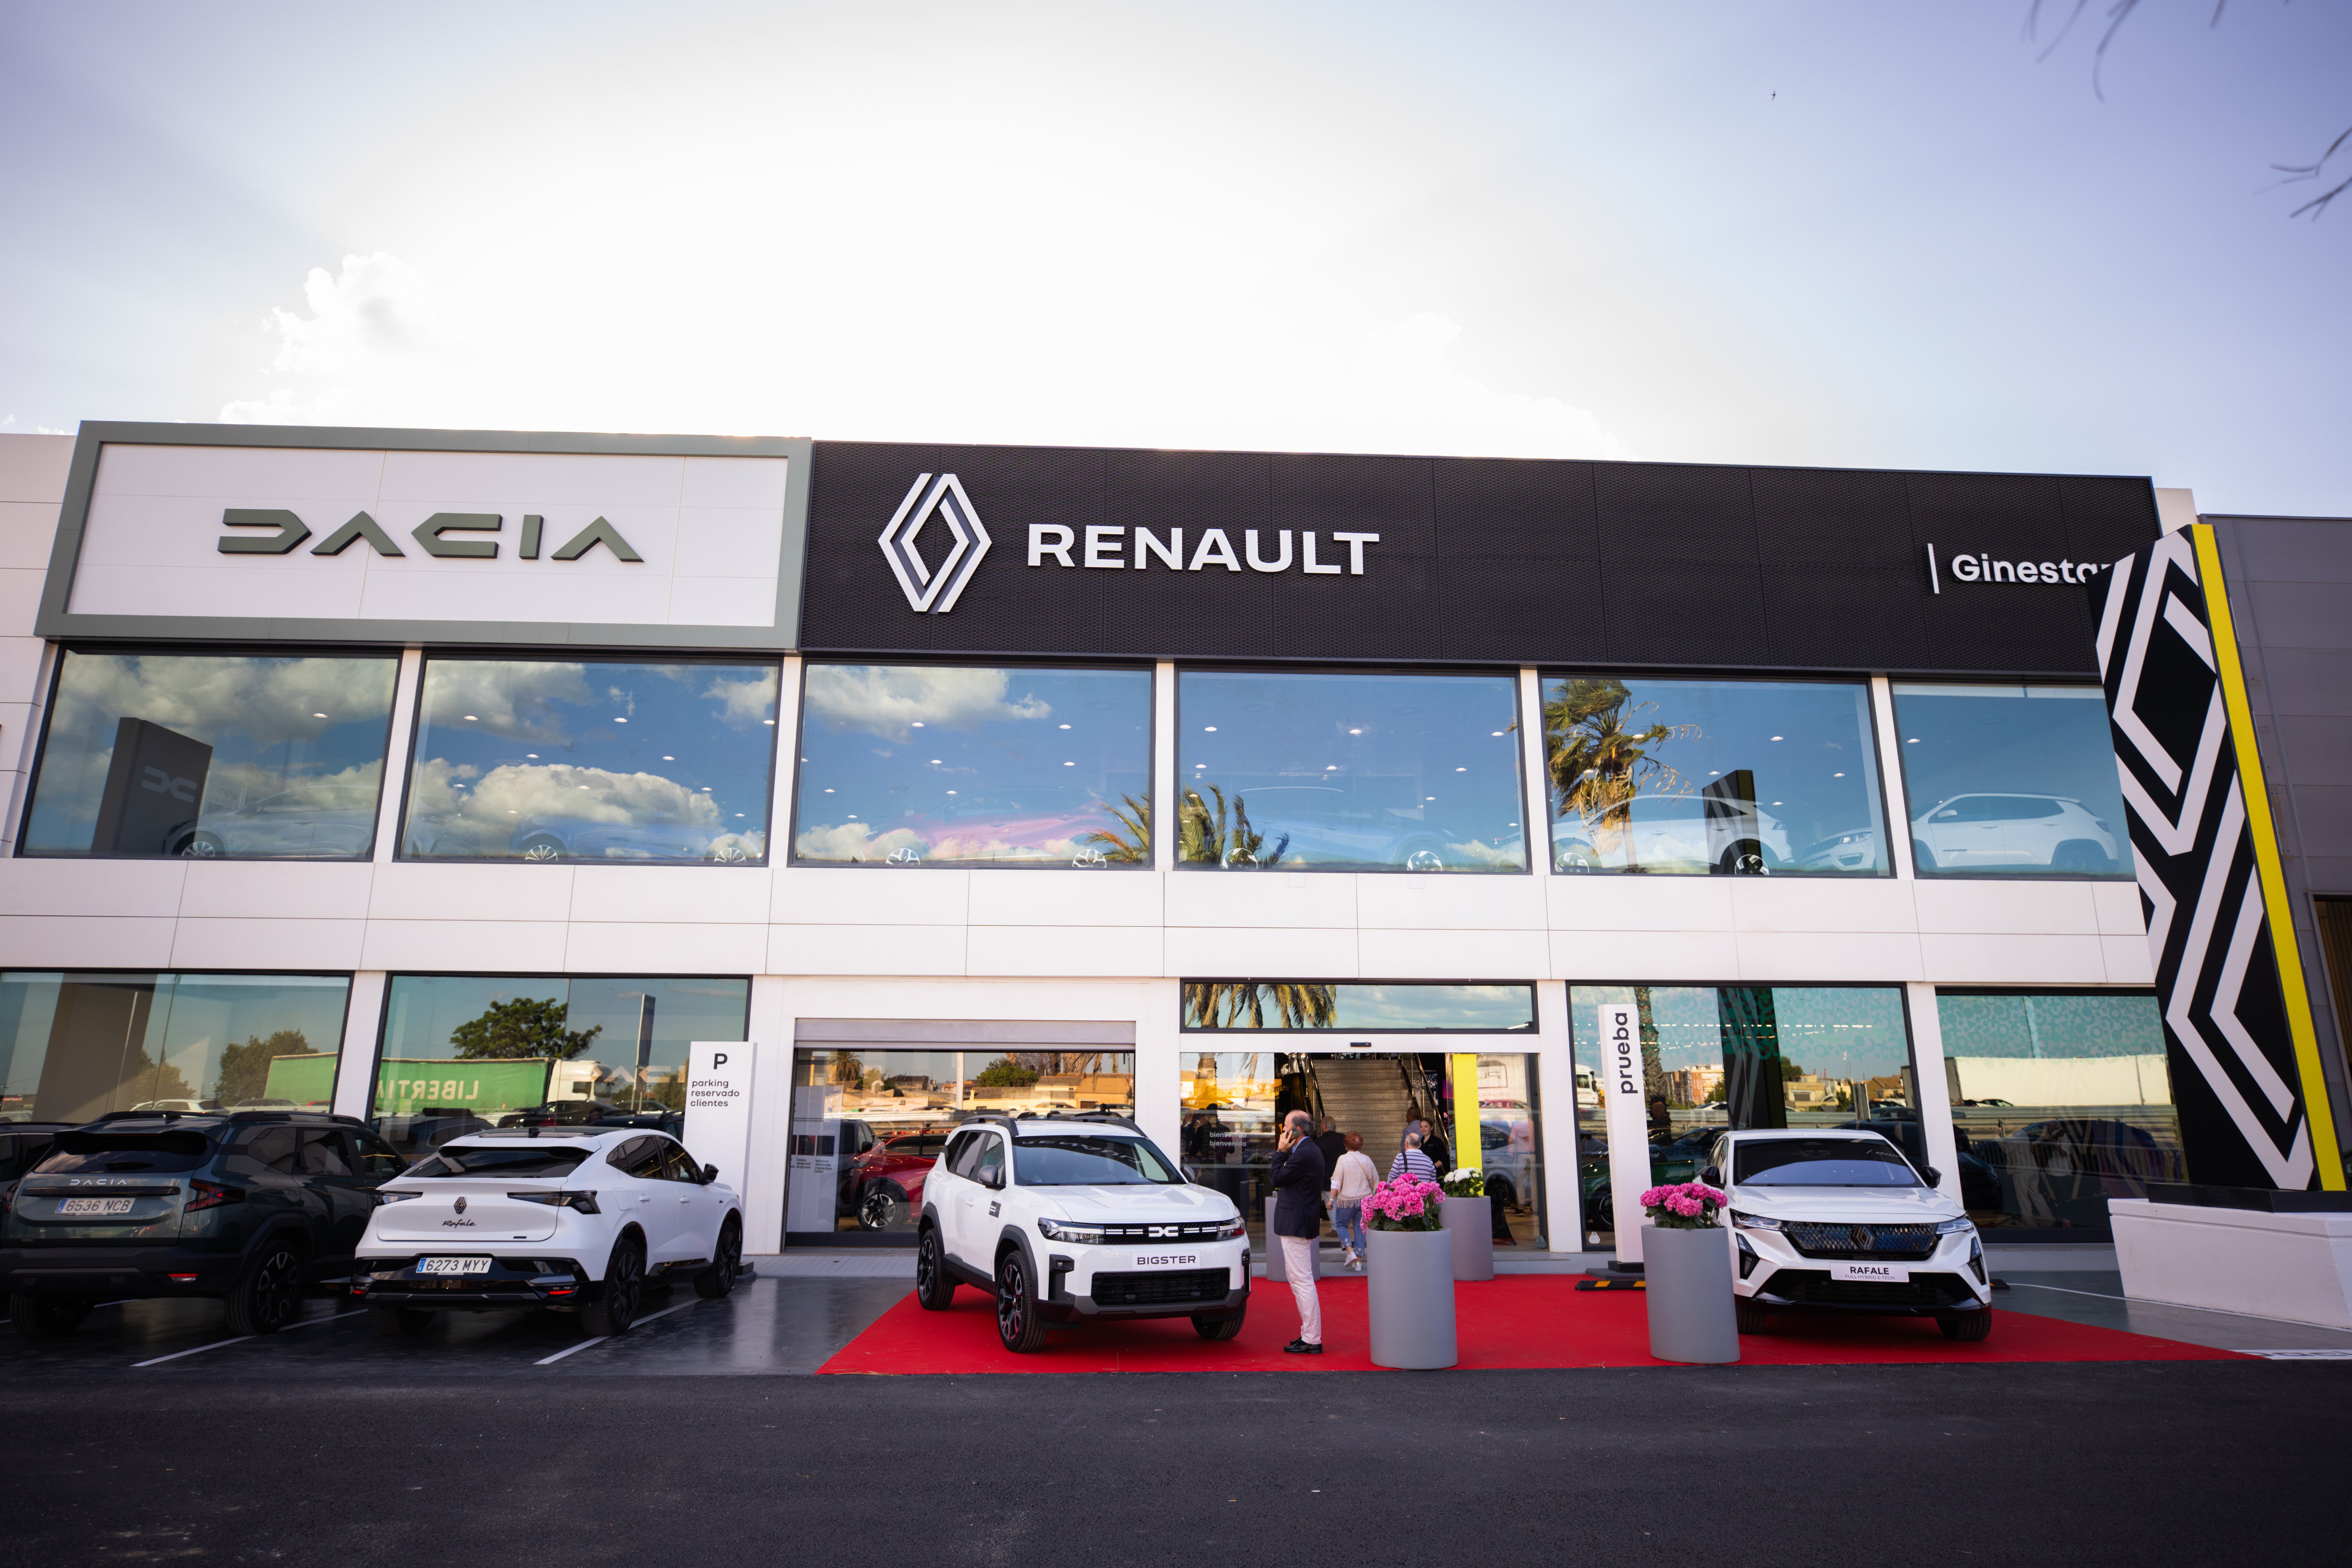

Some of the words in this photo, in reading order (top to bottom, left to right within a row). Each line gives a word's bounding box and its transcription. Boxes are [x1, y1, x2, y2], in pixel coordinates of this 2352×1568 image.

[217, 508, 644, 563] DACIA
[1028, 524, 1379, 575] RENAULT
[1952, 553, 2112, 583] Ginesta
[1613, 1013, 1638, 1094] prueba
[713, 1053, 728, 1069] P
[692, 1079, 729, 1088] parking
[66, 1200, 100, 1211] 6536
[103, 1200, 130, 1211] NCB
[442, 1219, 476, 1229] Rafale
[426, 1260, 459, 1270] 6273
[462, 1260, 488, 1271] MYY
[1137, 1256, 1196, 1265] BIGSTER
